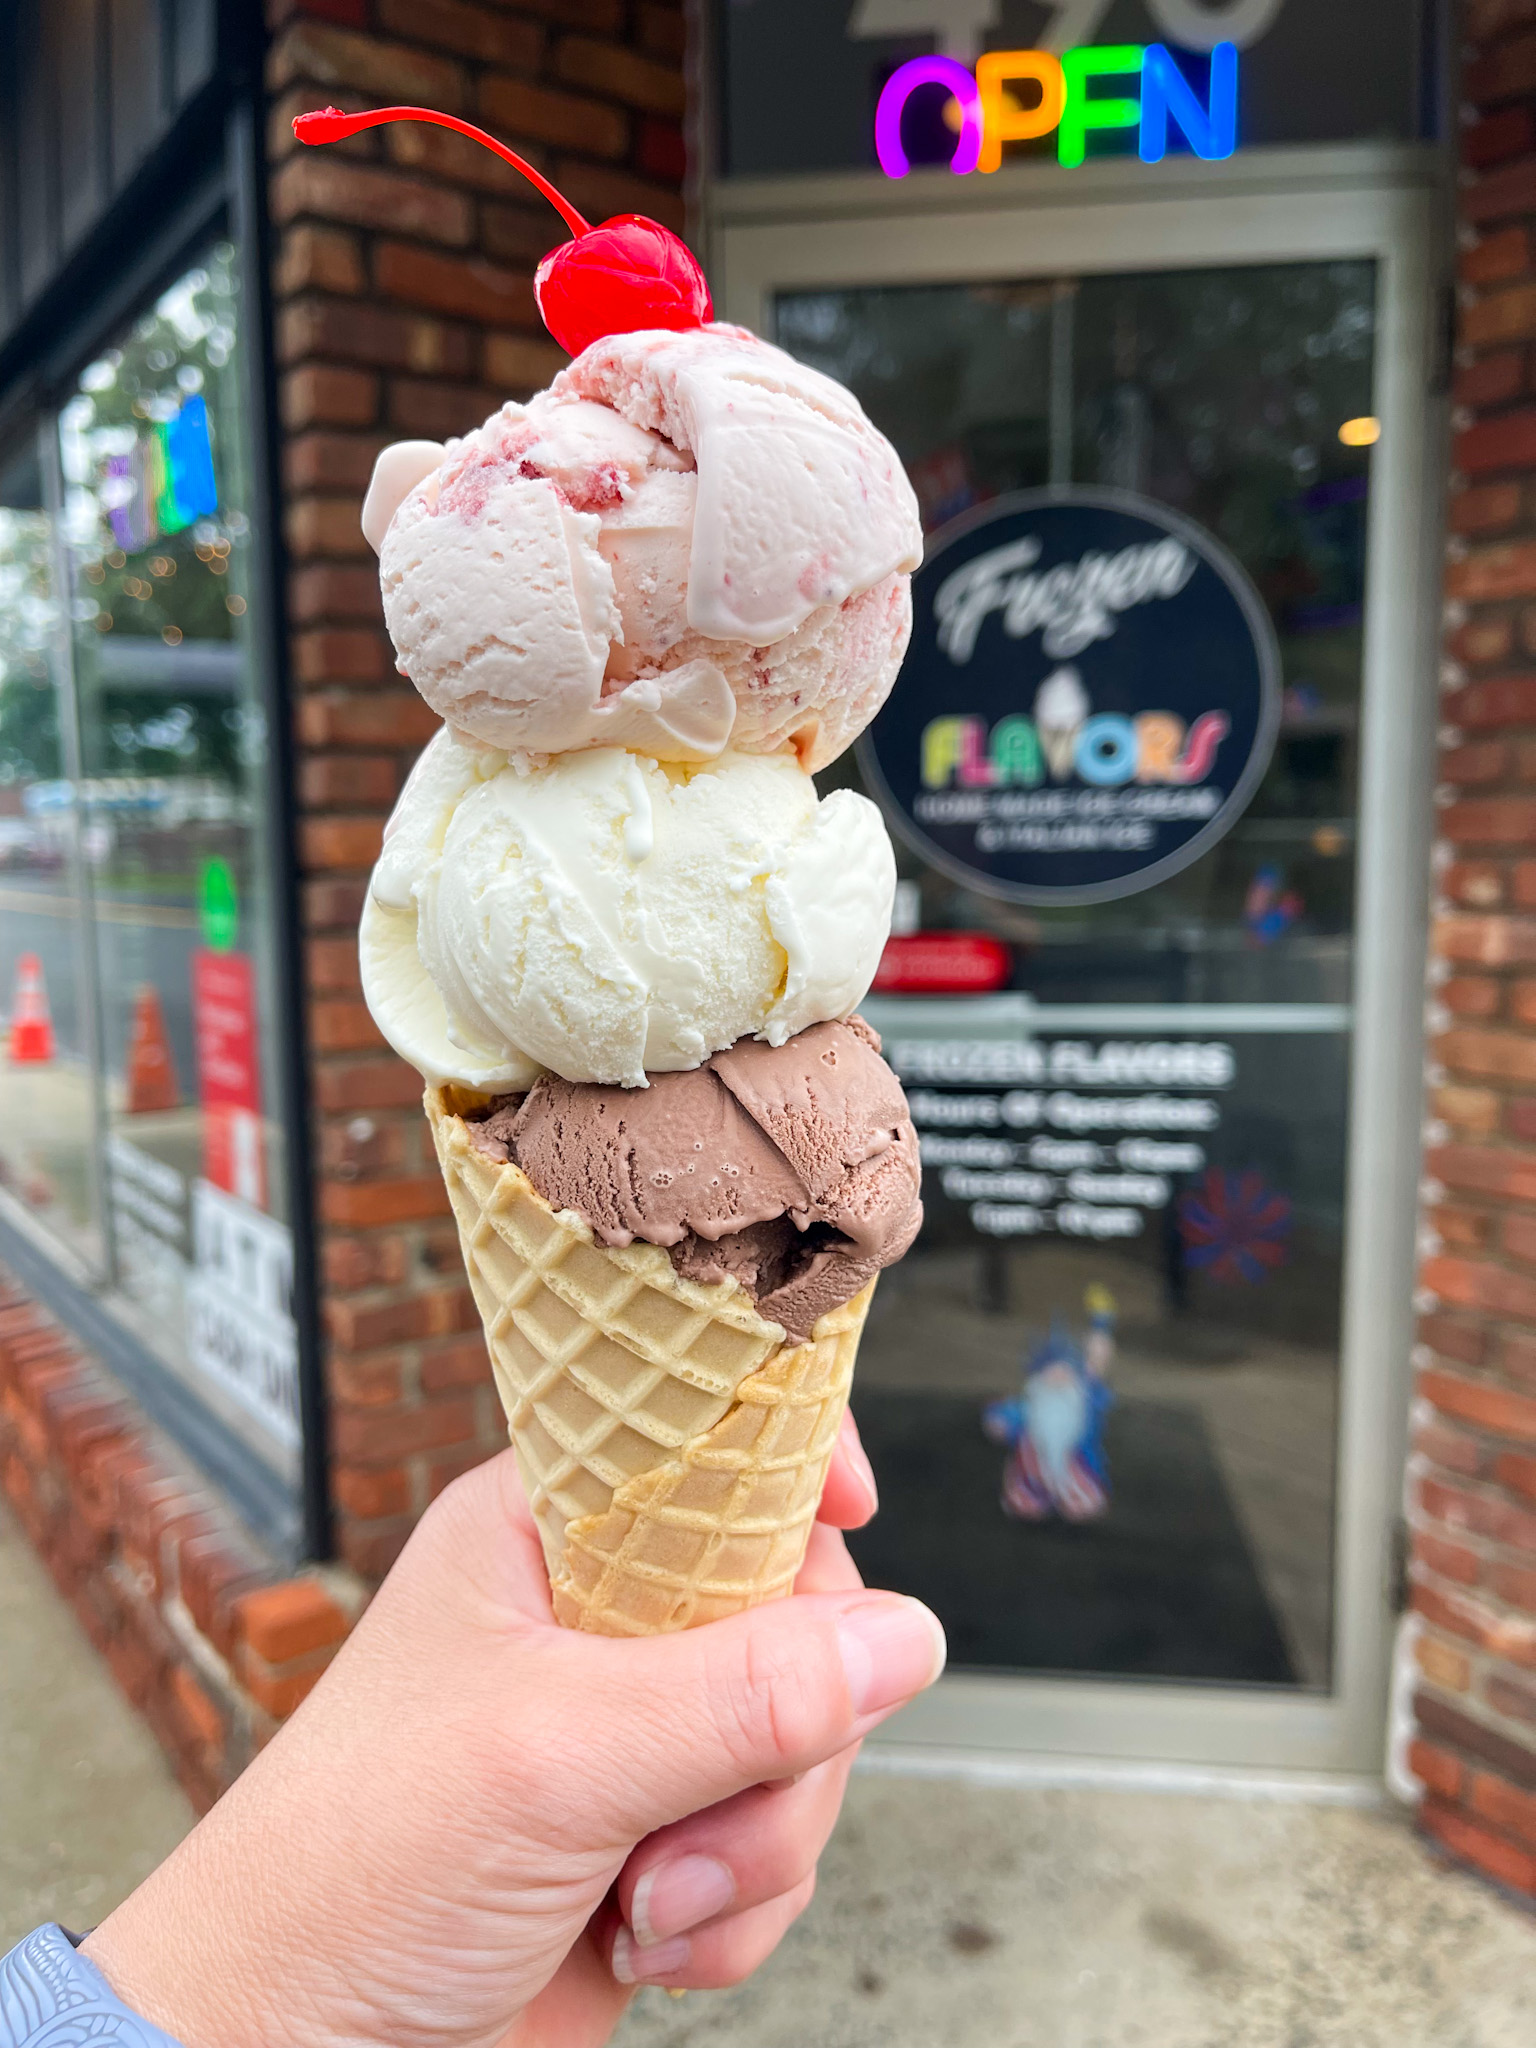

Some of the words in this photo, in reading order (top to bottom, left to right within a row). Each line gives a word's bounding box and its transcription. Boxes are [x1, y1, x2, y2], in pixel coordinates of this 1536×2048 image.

[876, 41, 1238, 178] OPEN
[935, 536, 1197, 662] Frozen
[923, 711, 1230, 788] FLAVORS
